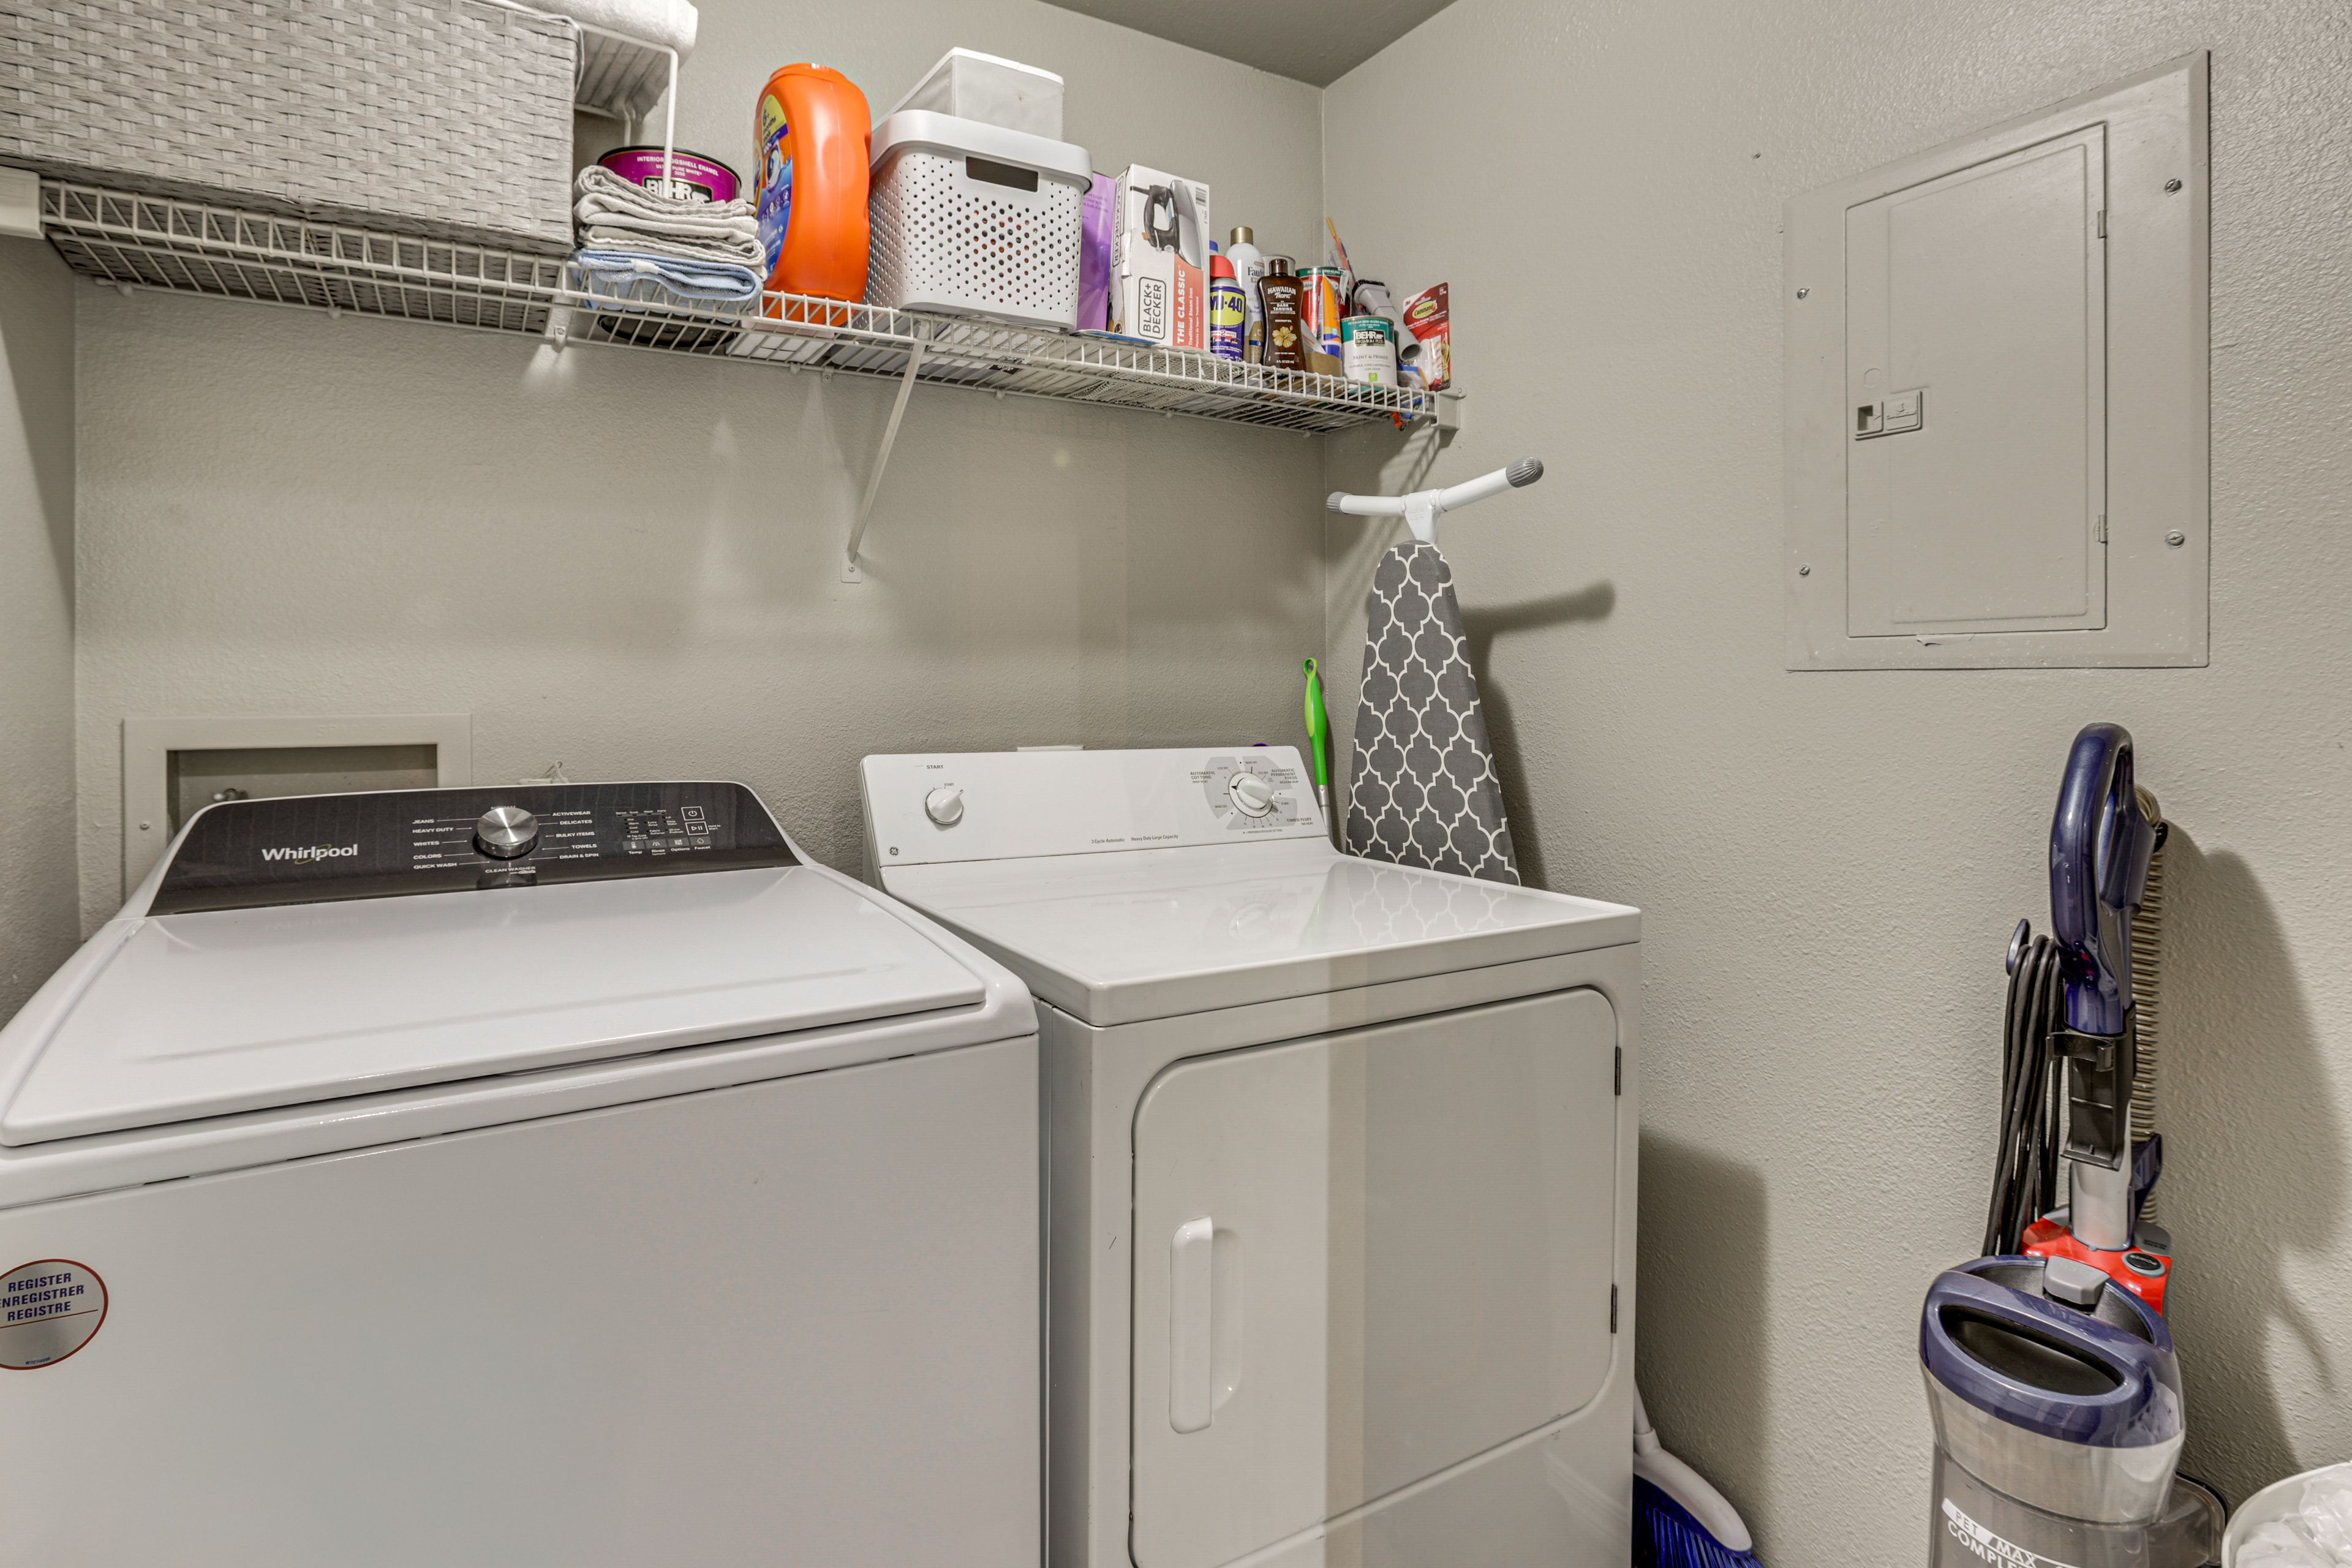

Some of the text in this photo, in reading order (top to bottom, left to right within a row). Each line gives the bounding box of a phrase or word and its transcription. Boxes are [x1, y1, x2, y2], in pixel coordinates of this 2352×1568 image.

[671, 158, 698, 169] GGSHELL
[698, 164, 719, 176] ENAMEL
[1267, 286, 1297, 295] HAWAIIAN
[1143, 283, 1152, 332] BLACK+
[1152, 284, 1161, 334] DECKER
[1414, 304, 1434, 317] Command
[261, 843, 358, 862] Whirlpool
[8, 1273, 72, 1292] REGISTER
[0, 1284, 85, 1308] NREGISTRER
[7, 1301, 71, 1321] REGISTRE
[1955, 1510, 2037, 1568] PET MAX
